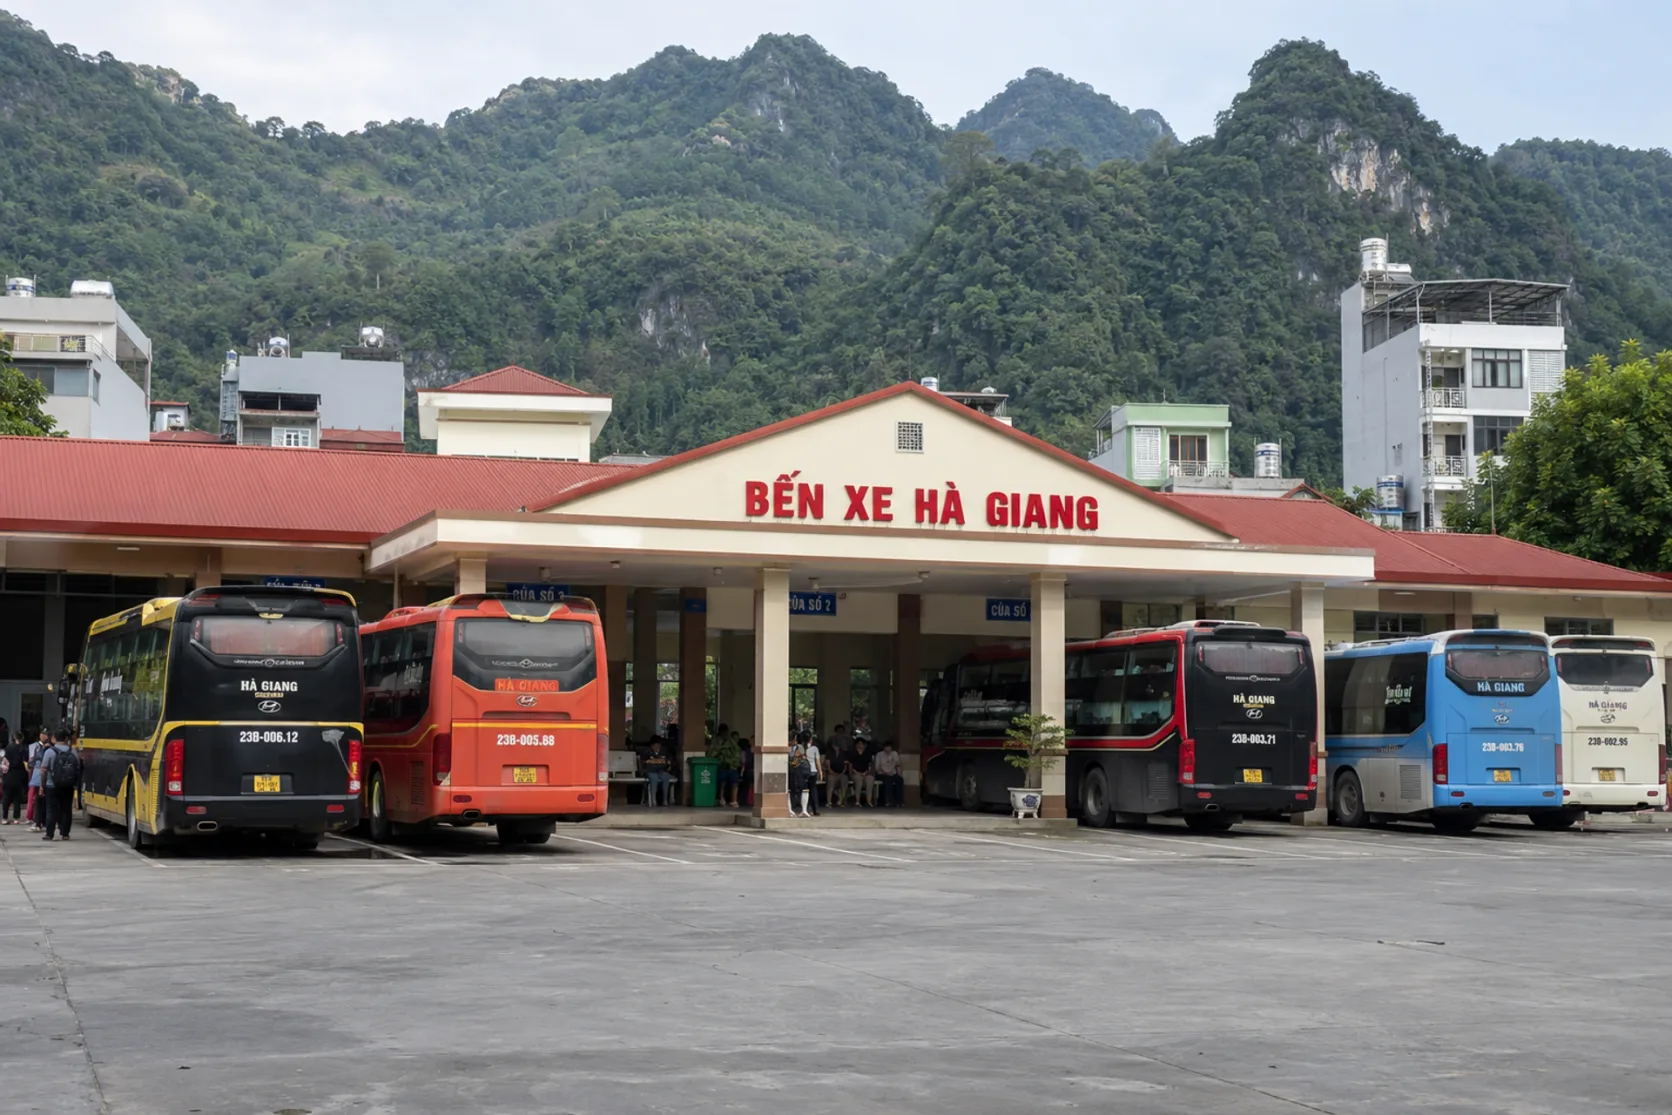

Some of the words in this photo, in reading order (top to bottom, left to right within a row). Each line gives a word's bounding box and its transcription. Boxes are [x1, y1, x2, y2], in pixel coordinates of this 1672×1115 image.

[745, 470, 824, 519] BẾN
[844, 485, 893, 522] XE
[915, 481, 965, 525] HÀ
[986, 491, 1099, 530] GIANG
[825, 599, 831, 611] 2
[241, 678, 257, 691] HÀ
[261, 681, 298, 692] GIANG
[1494, 682, 1525, 692] GIANG
[1249, 695, 1275, 704] GIANG
[240, 731, 299, 743] 23B-006.12
